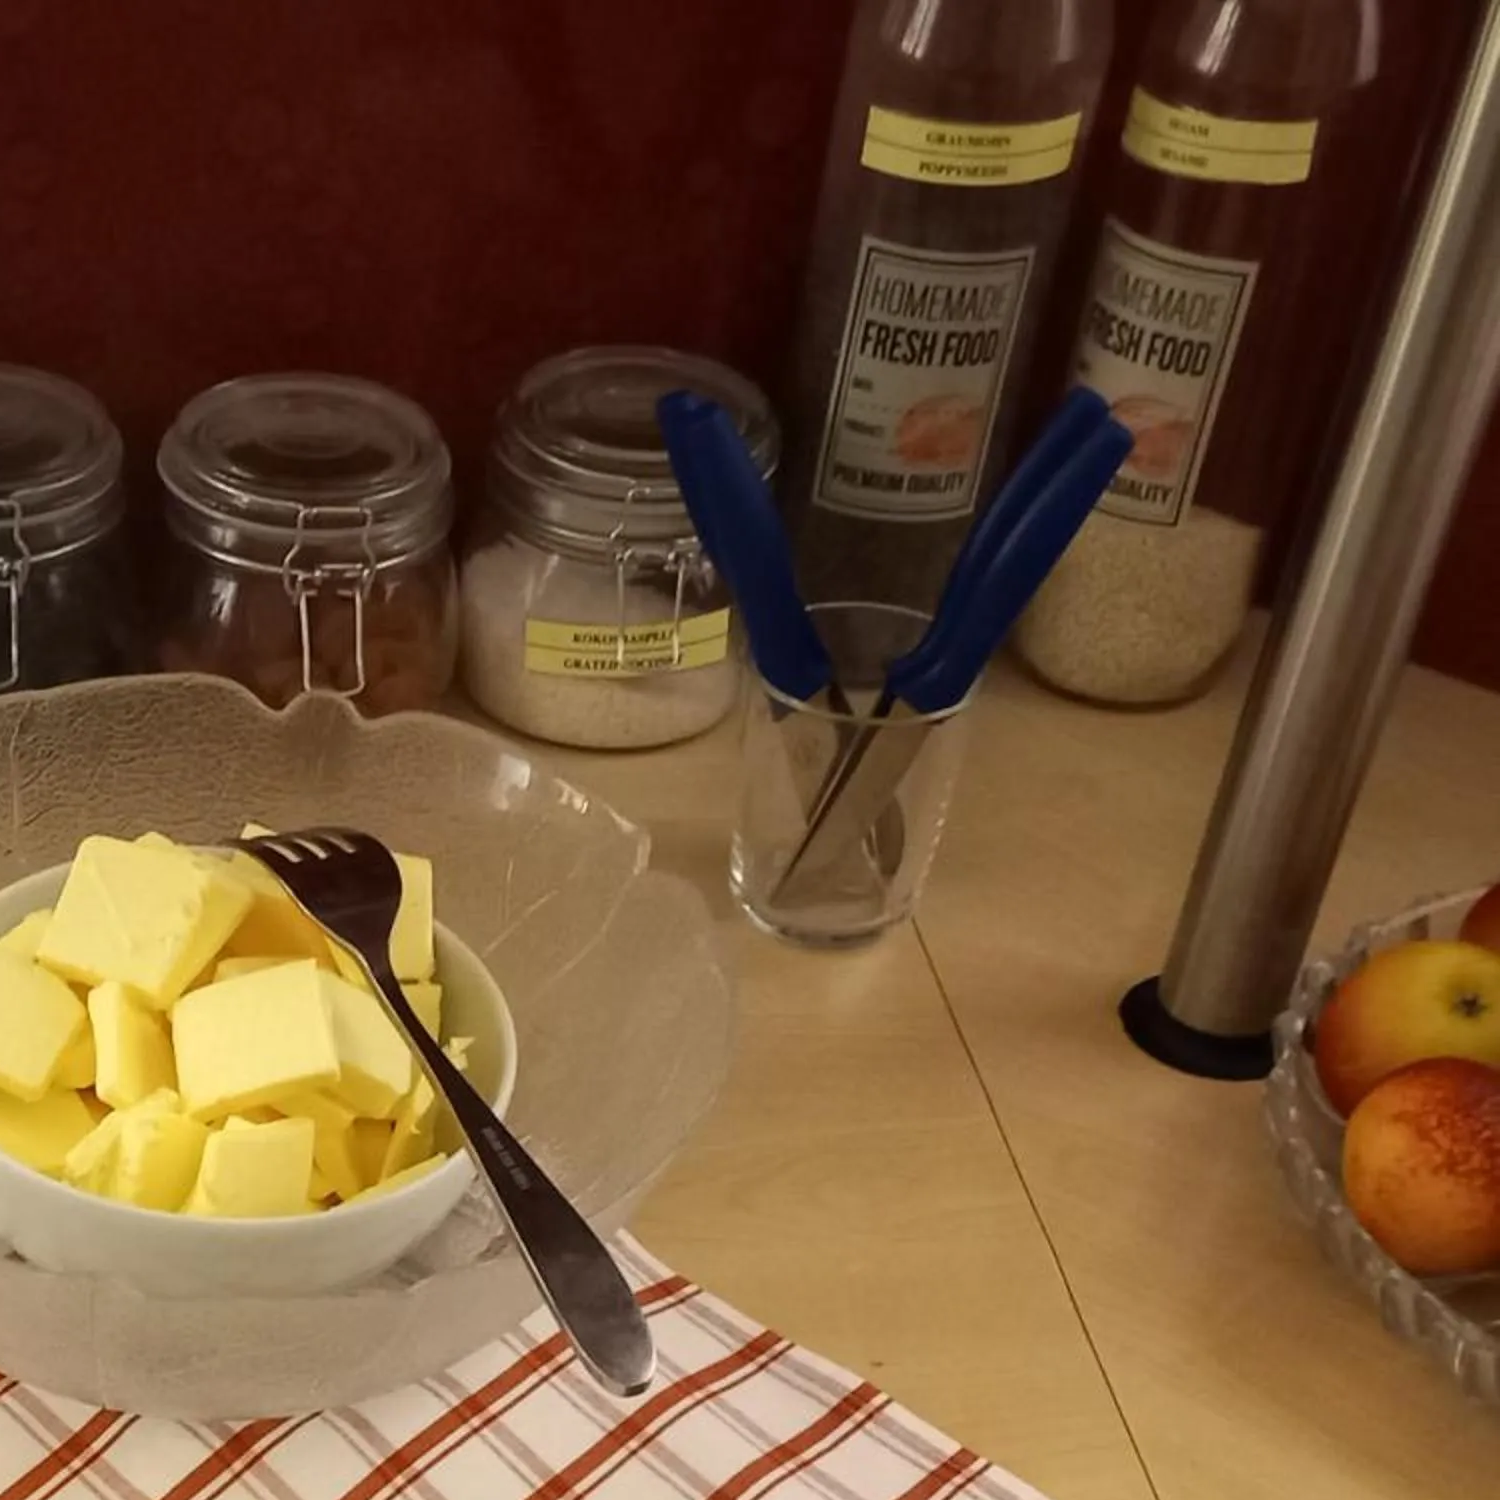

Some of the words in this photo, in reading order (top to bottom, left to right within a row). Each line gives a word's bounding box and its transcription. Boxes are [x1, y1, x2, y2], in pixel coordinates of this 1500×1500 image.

[869, 273, 1011, 323] HOMEMADE
[859, 319, 935, 367] FRESH
[940, 328, 999, 367] FOOD
[1145, 331, 1212, 377] FOOD
